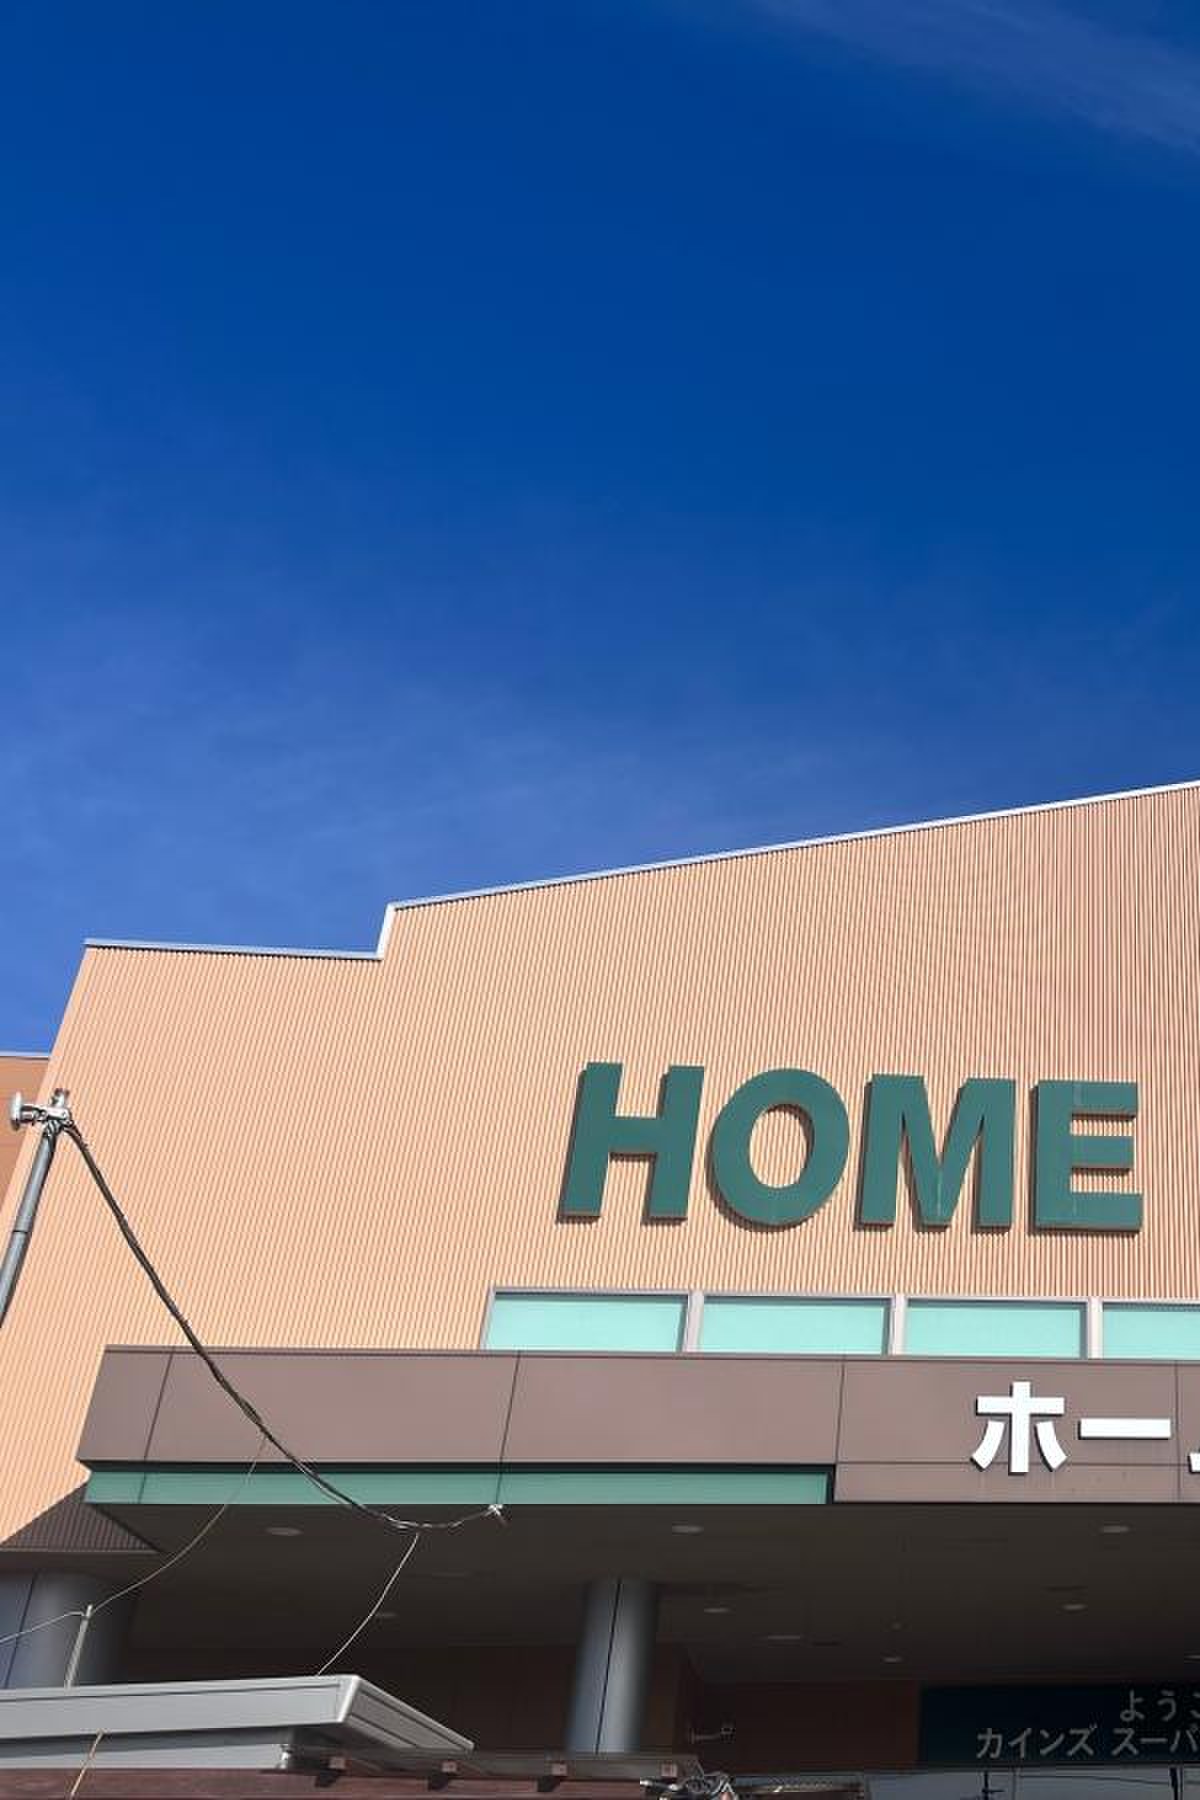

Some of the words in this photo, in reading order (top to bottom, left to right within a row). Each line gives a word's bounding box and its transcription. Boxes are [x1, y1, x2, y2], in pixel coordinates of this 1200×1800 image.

[558, 1061, 1144, 1234] HOME
[976, 1725, 1096, 1760] カインズ
